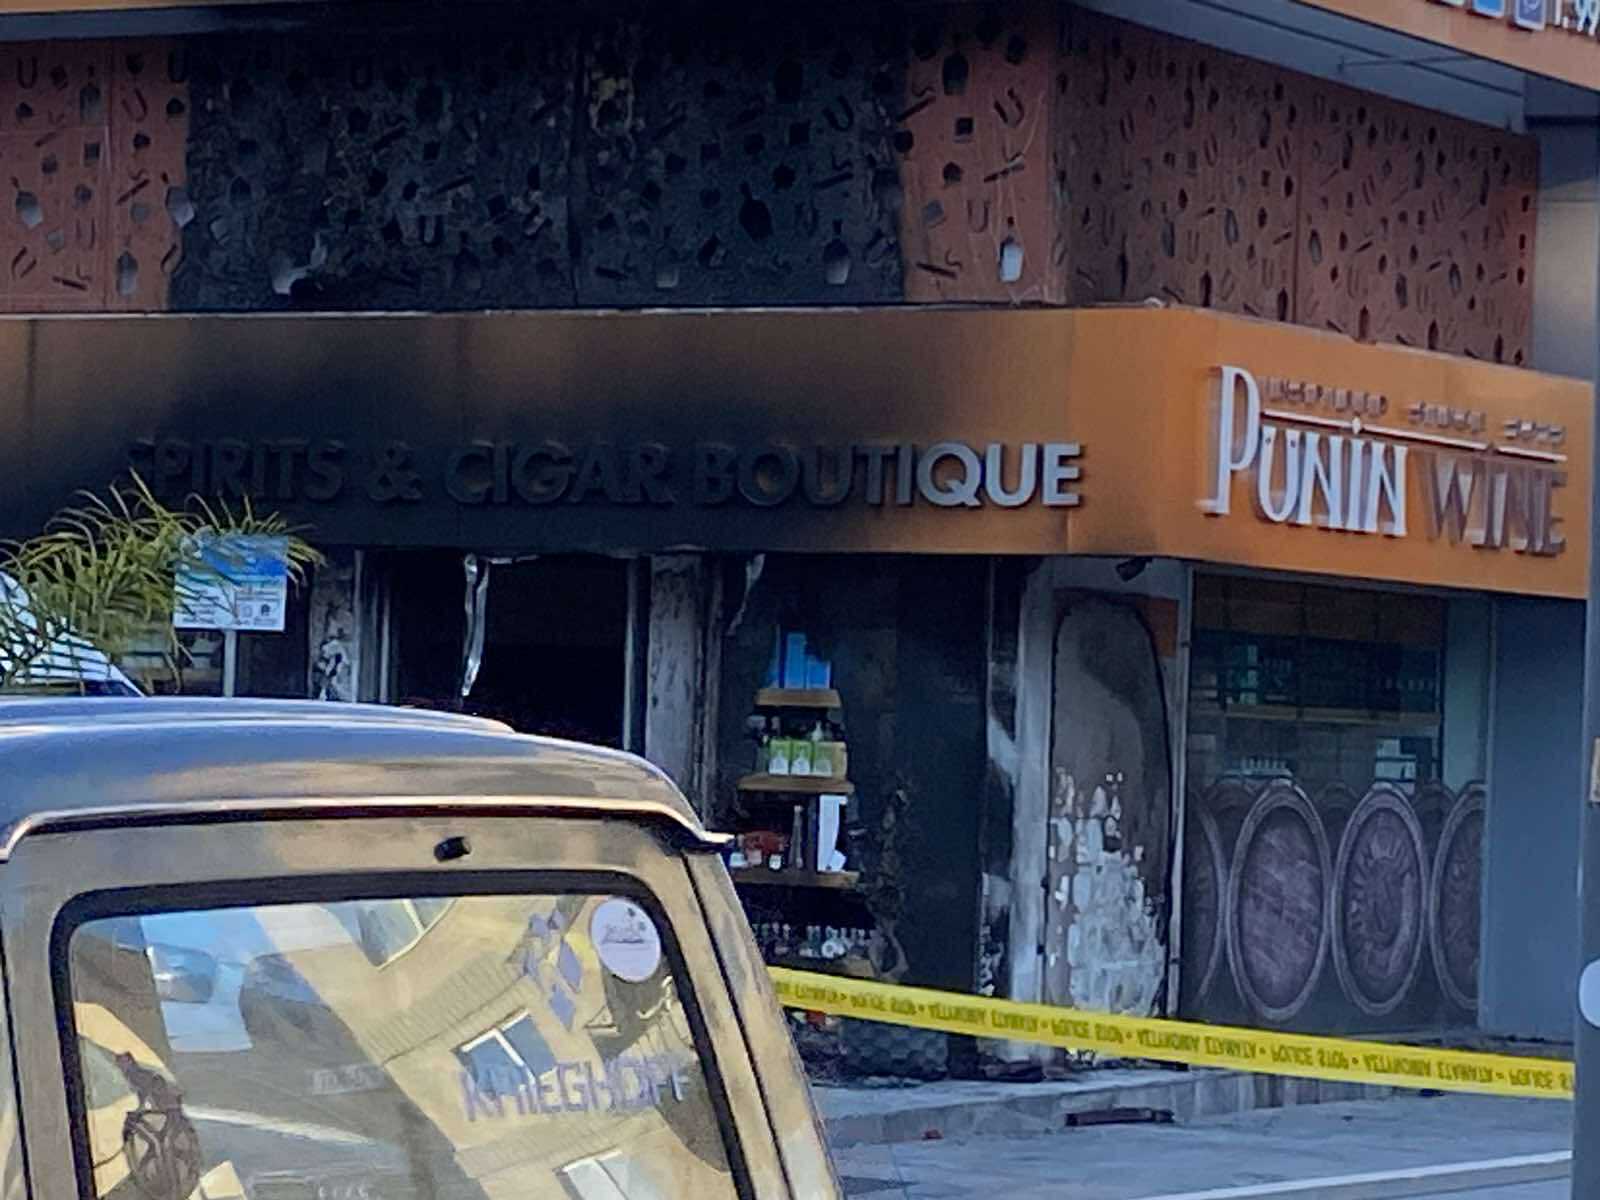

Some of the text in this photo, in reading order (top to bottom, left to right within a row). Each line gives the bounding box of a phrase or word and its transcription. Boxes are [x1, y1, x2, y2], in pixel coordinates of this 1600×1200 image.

[363, 442, 424, 503] &
[445, 439, 679, 505] CIGAR
[694, 440, 1081, 508] BOUTIQUE
[1413, 450, 1567, 556] WINE
